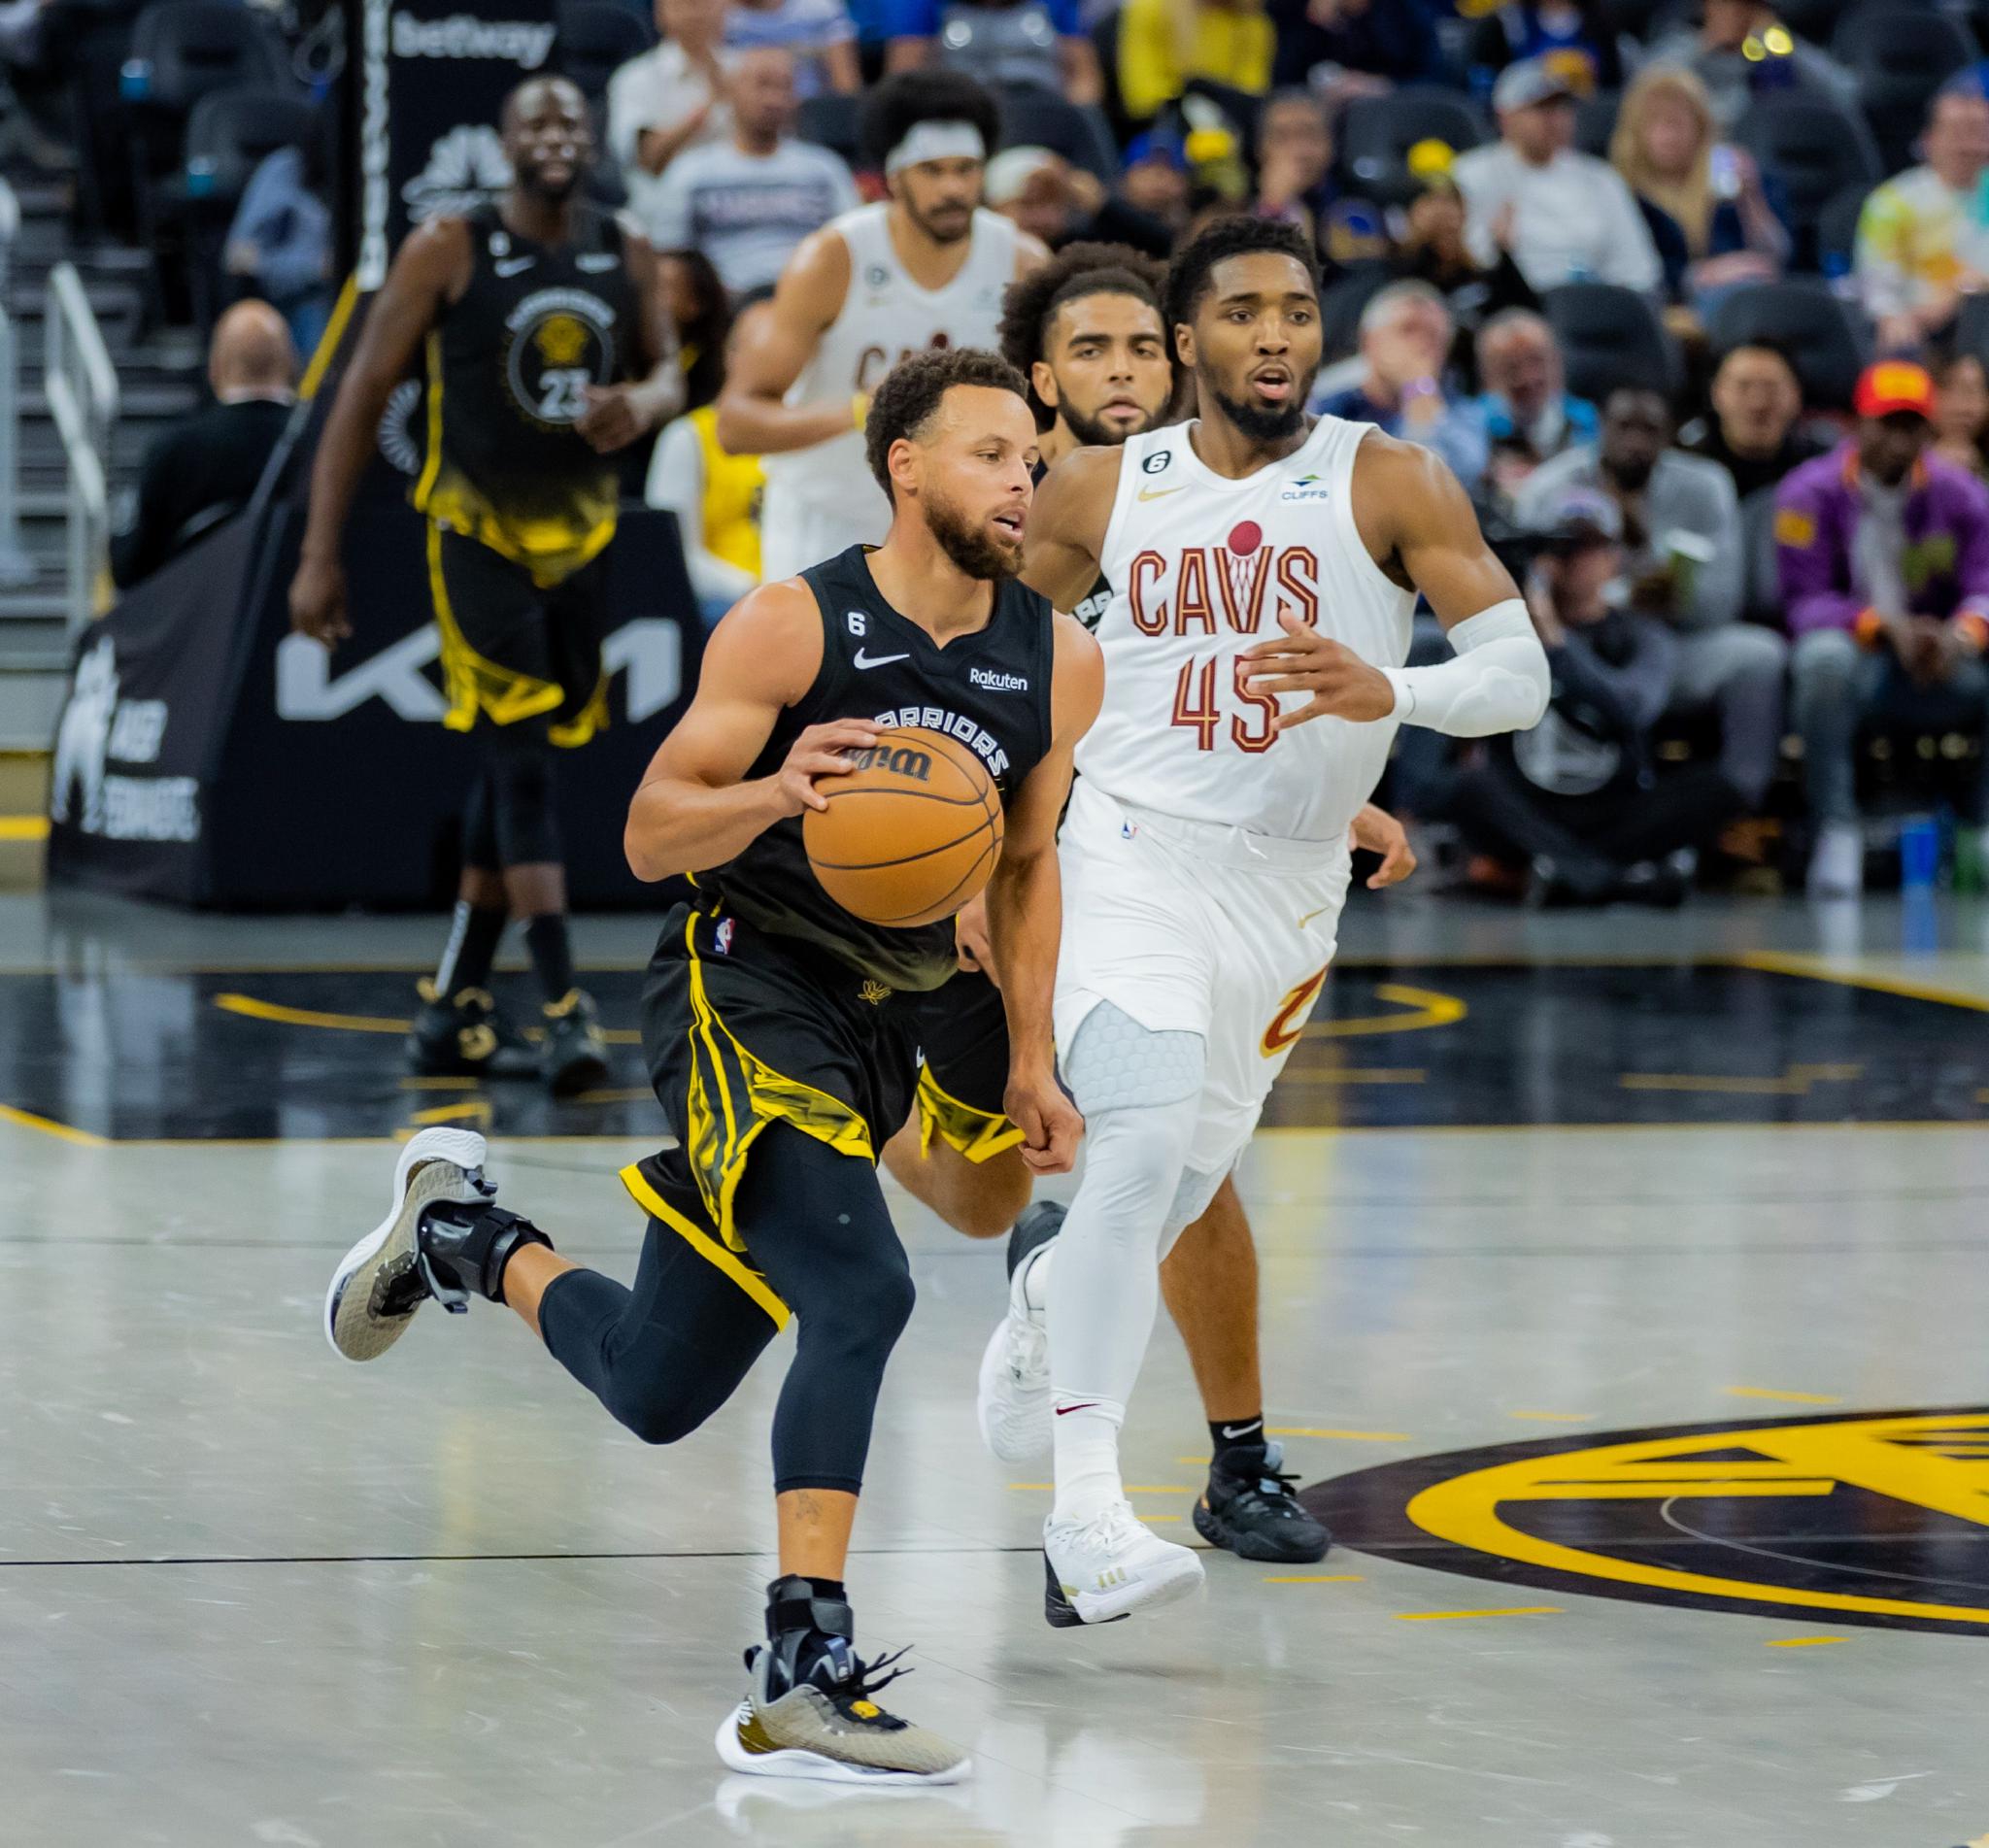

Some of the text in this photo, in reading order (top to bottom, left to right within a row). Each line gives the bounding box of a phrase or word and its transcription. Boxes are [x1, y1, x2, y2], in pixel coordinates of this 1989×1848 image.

[391, 11, 556, 69] betway
[538, 368, 590, 418] 23
[1144, 452, 1170, 473] 6
[1281, 489, 1329, 500] CLIFFS
[1129, 546, 1319, 637] CAVS
[847, 612, 866, 636] 6
[969, 668, 1028, 691] Rakuten
[1170, 654, 1281, 754] 45
[875, 706, 1011, 778] ARRIORS
